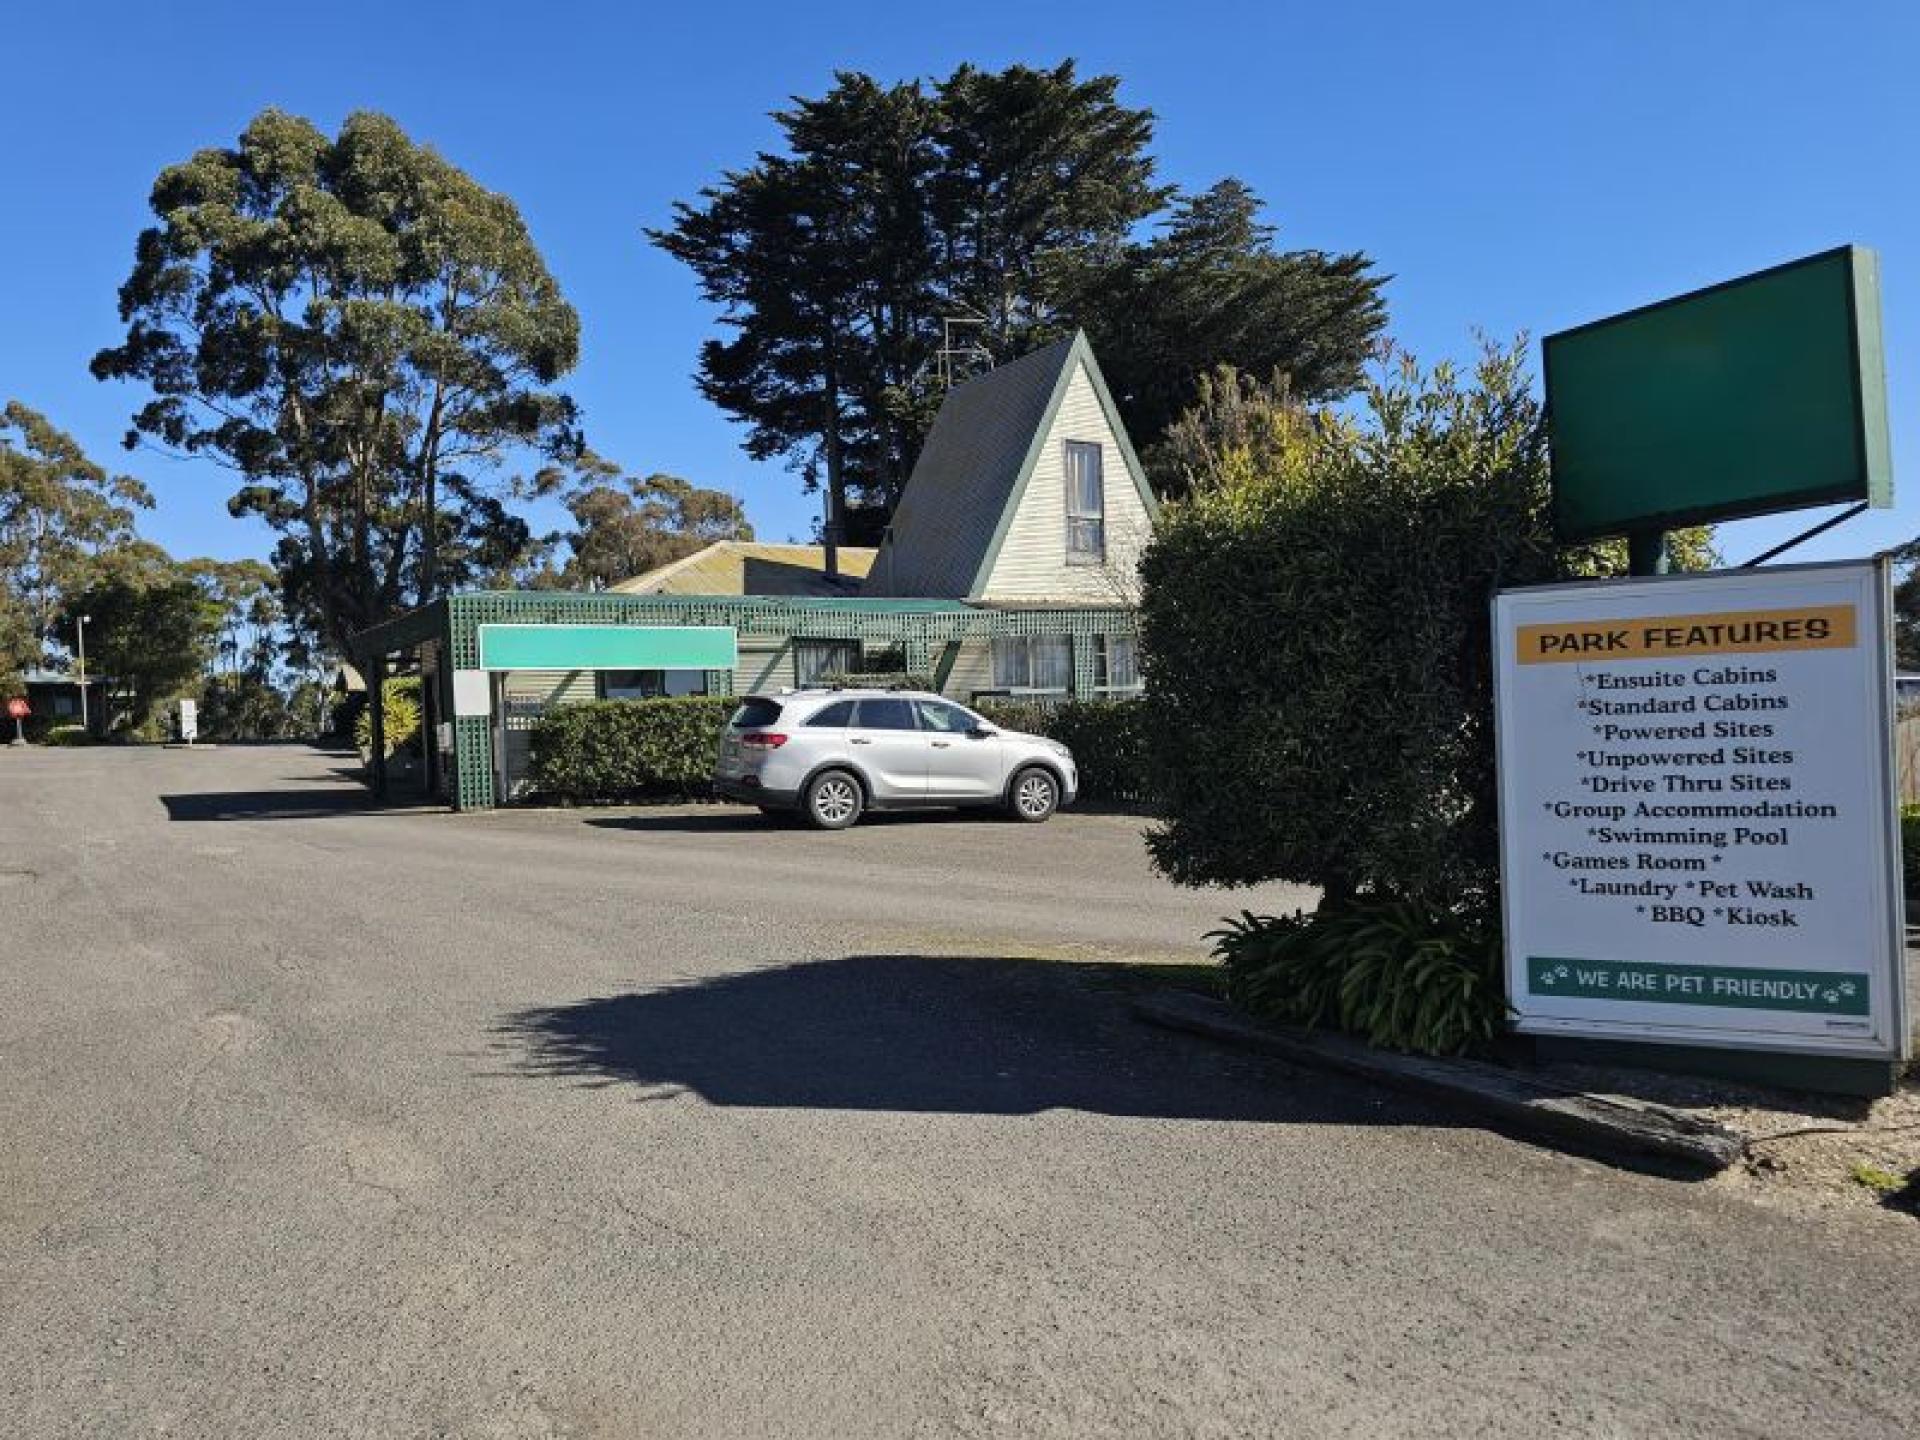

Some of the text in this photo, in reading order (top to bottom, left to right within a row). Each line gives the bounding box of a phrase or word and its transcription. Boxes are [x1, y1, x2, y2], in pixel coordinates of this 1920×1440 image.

[1540, 618, 1832, 653] PARK FEATURES
[1694, 667, 1777, 685] Cabins
[1704, 692, 1789, 712] Cabins
[1713, 721, 1775, 738] Sites
[1732, 748, 1794, 765] Sites
[1663, 775, 1722, 792] Thru
[1730, 774, 1792, 791] Sites
[1634, 800, 1838, 817] Accommodation
[1735, 827, 1789, 845] Pool
[1637, 854, 1706, 870] Room
[1747, 881, 1814, 900] Wash
[1576, 970, 1820, 1000] WE ARE PET FRIENDLY
